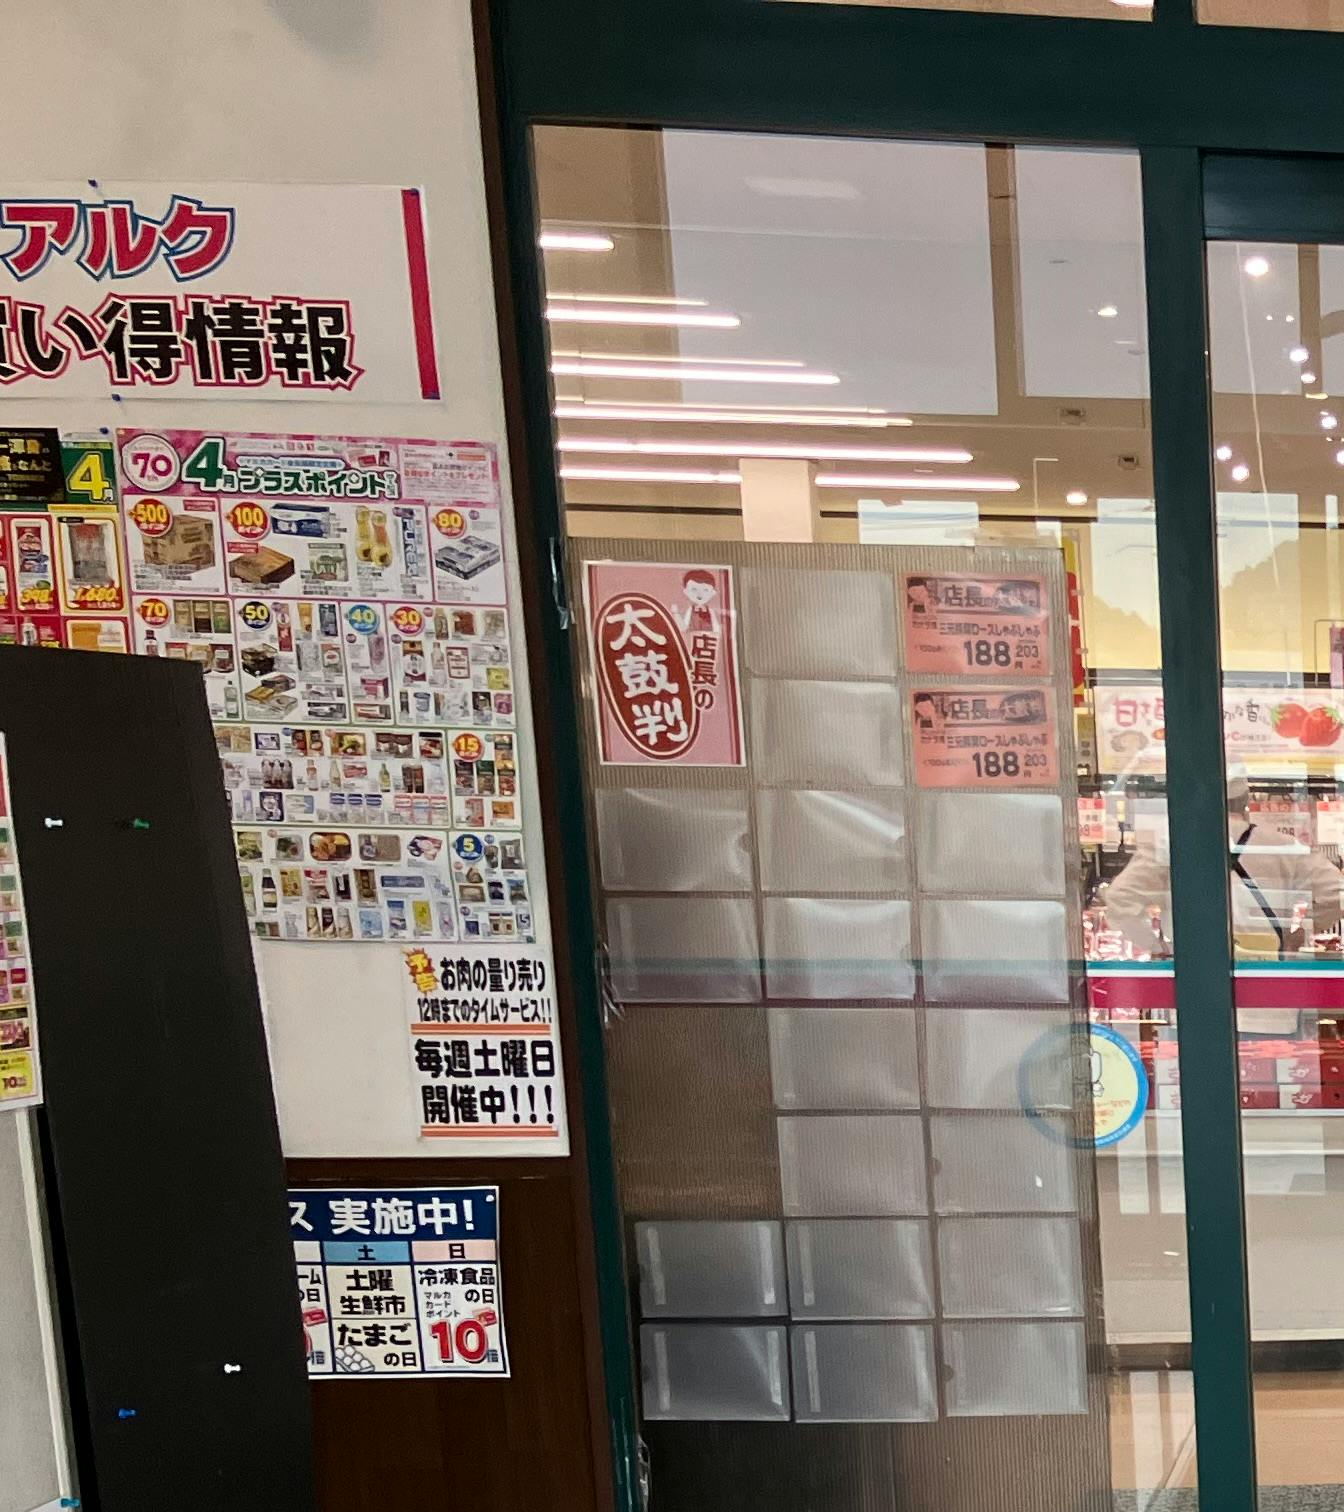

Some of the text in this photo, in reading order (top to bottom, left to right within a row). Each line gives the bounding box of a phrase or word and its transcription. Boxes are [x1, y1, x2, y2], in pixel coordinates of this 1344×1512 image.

[2, 195, 235, 281] アルク
[0, 295, 365, 391] い得情報
[963, 639, 1011, 667] 188
[606, 602, 690, 746] 太鼓判
[692, 633, 719, 711] 店長の
[971, 751, 1020, 778] 188
[440, 957, 546, 993] お肉の量り売り
[417, 997, 552, 1024] 12時までのタイムサービス!!
[414, 1039, 555, 1078] 毎週土曜日
[421, 1084, 554, 1124] 開催中!!!
[328, 1197, 475, 1236] 実施中!
[357, 1244, 376, 1261] 土
[448, 1243, 466, 1260] 日
[346, 1269, 394, 1292] 土曜
[418, 1268, 496, 1286] 冷凍食品
[340, 1296, 406, 1316] 生鮮市
[464, 1288, 495, 1305] の日
[425, 1309, 460, 1319] ポイント
[337, 1323, 412, 1347] たまご
[383, 1351, 418, 1367] の日
